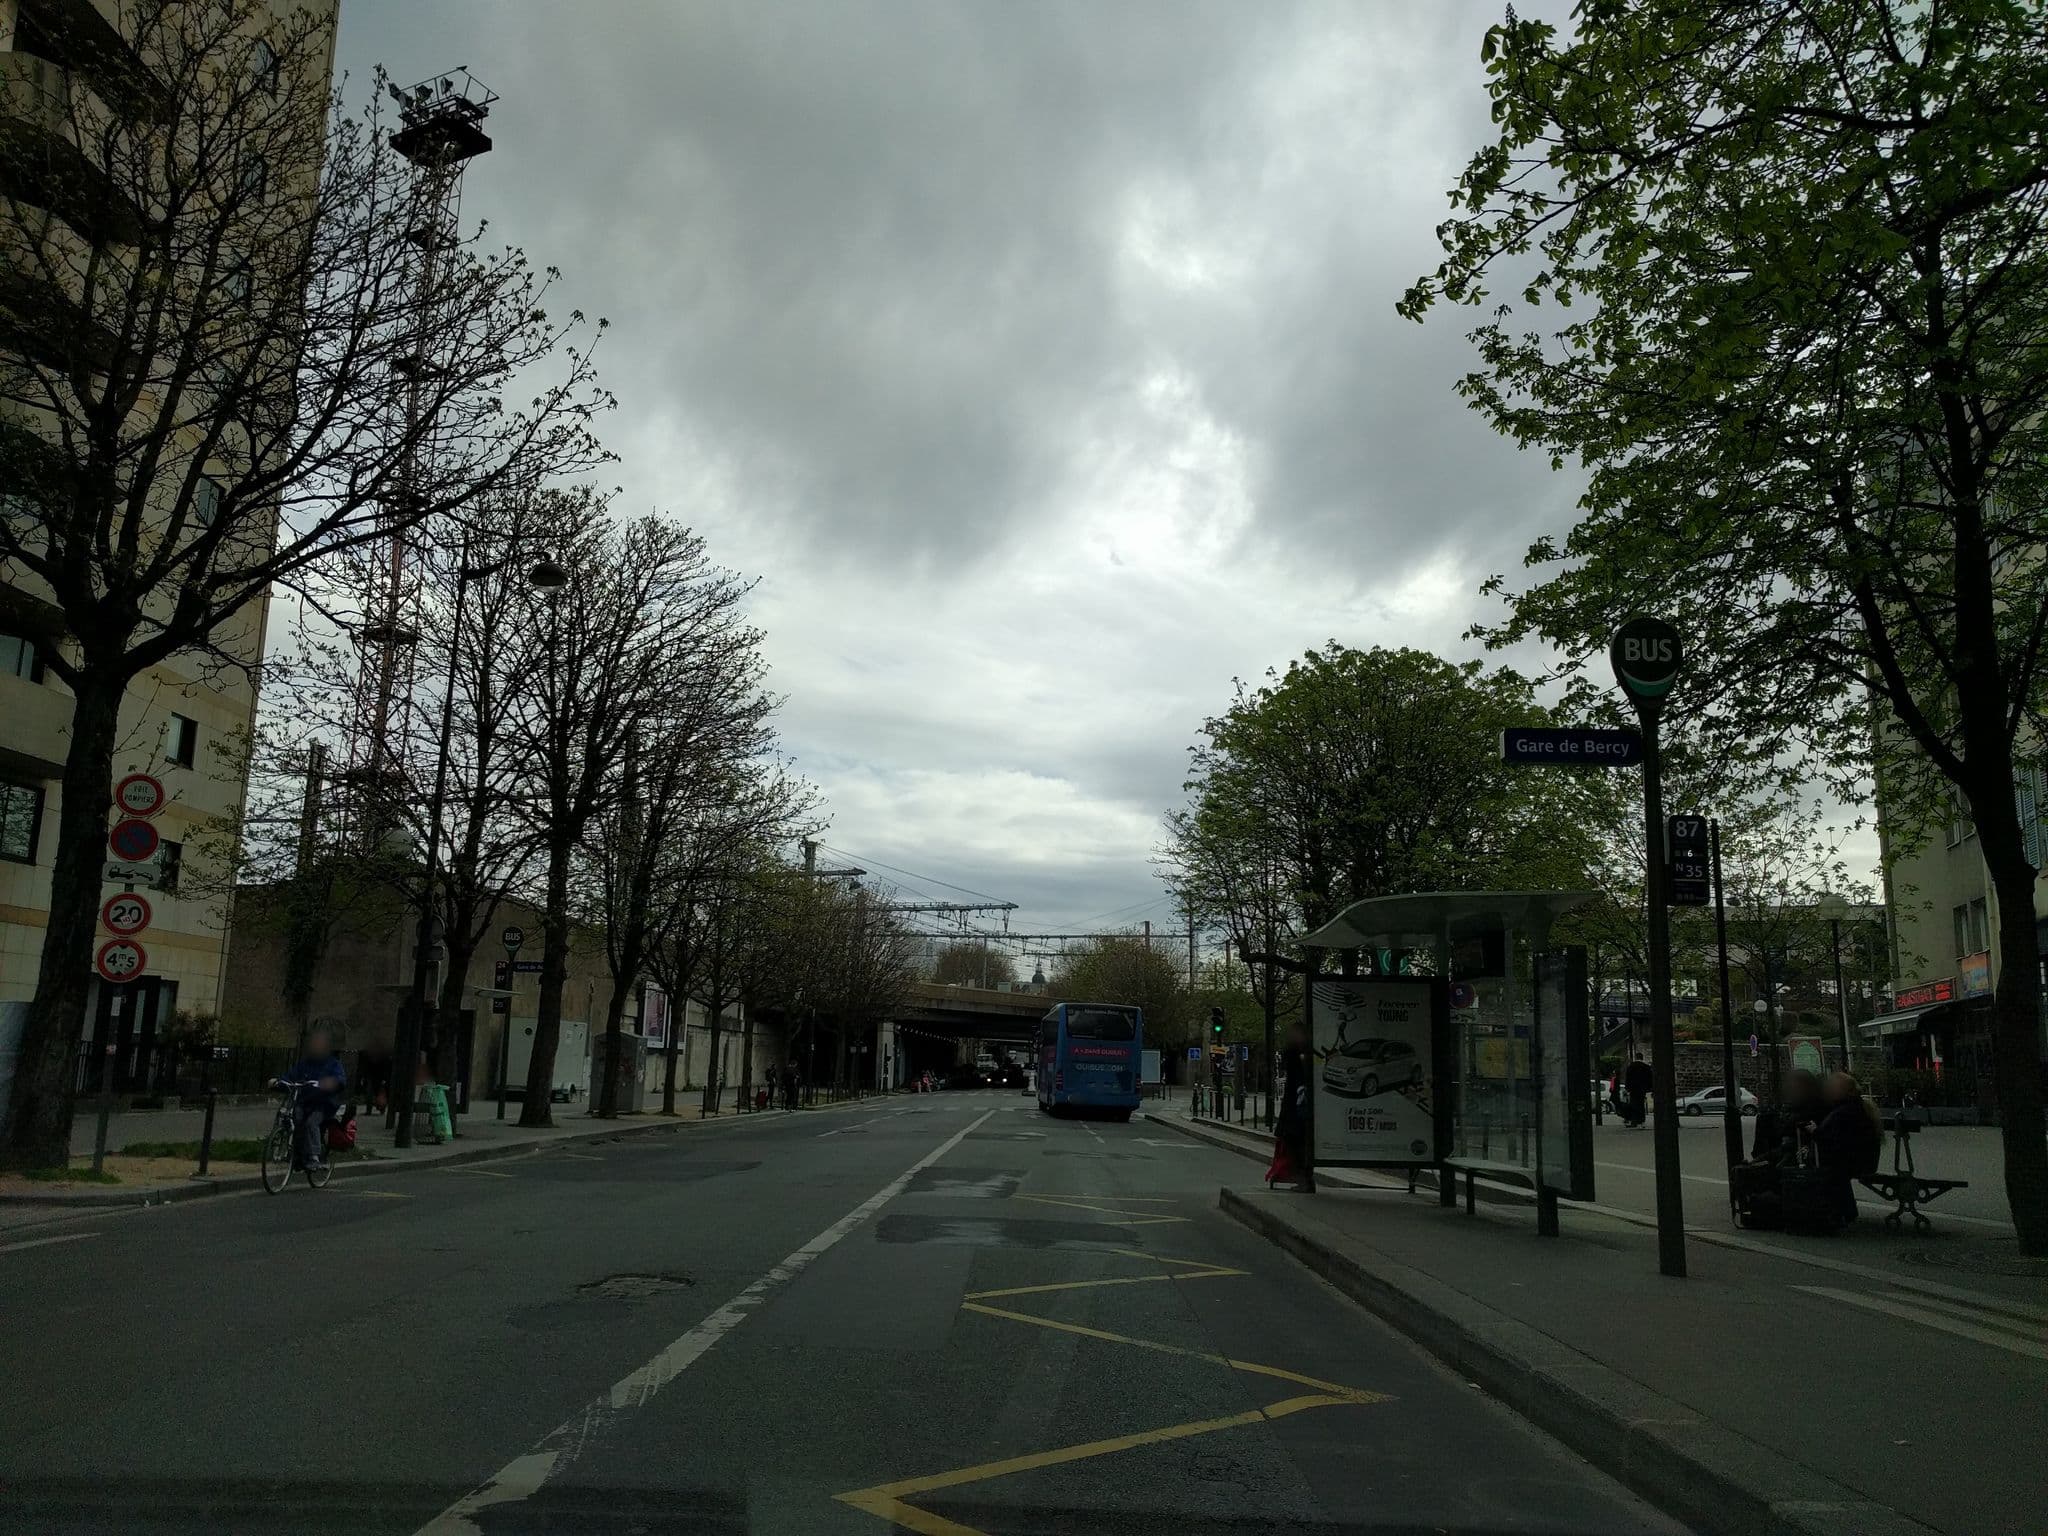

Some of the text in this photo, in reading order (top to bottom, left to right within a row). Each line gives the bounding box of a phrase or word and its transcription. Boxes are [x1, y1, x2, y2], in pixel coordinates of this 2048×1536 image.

[1624, 637, 1673, 662] BUS
[1516, 738, 1630, 757] Gare de Bercy
[1675, 820, 1699, 837] 87
[112, 905, 142, 924] 20
[505, 932, 521, 941] BUS
[1377, 1009, 1409, 1022] YOUNG
[1348, 1116, 1365, 1130] 109
